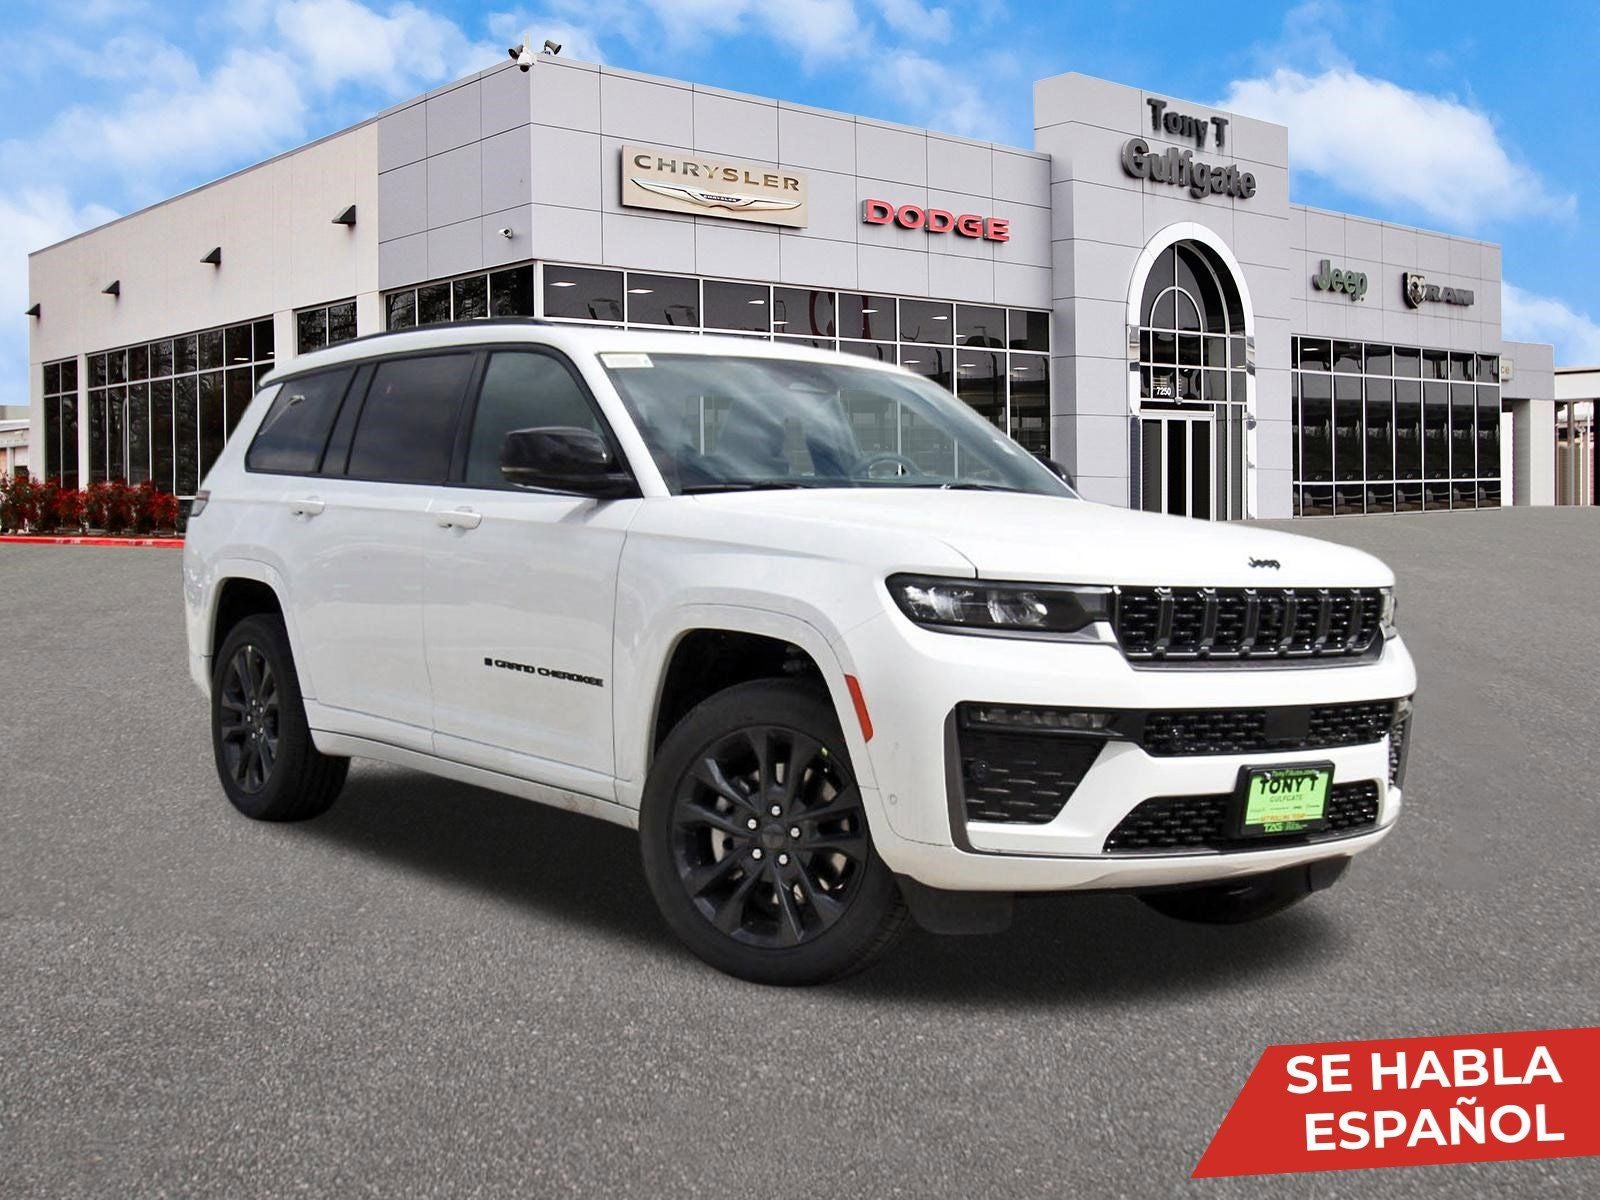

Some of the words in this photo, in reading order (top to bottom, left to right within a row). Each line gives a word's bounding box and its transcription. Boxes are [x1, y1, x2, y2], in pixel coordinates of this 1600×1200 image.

[1147, 98, 1208, 148] Tony
[1210, 117, 1229, 148] T
[633, 154, 800, 192] CHRYSLER
[1121, 138, 1257, 199] Gulfgate
[862, 198, 1011, 243] DODGE
[1312, 259, 1368, 303] Jeep
[1424, 283, 1475, 307] RAM
[1156, 386, 1172, 396] 7250
[494, 659, 535, 674] GRAND
[537, 667, 604, 687] CHEROKEE
[1259, 776, 1304, 795] TONY
[1310, 774, 1319, 792] T
